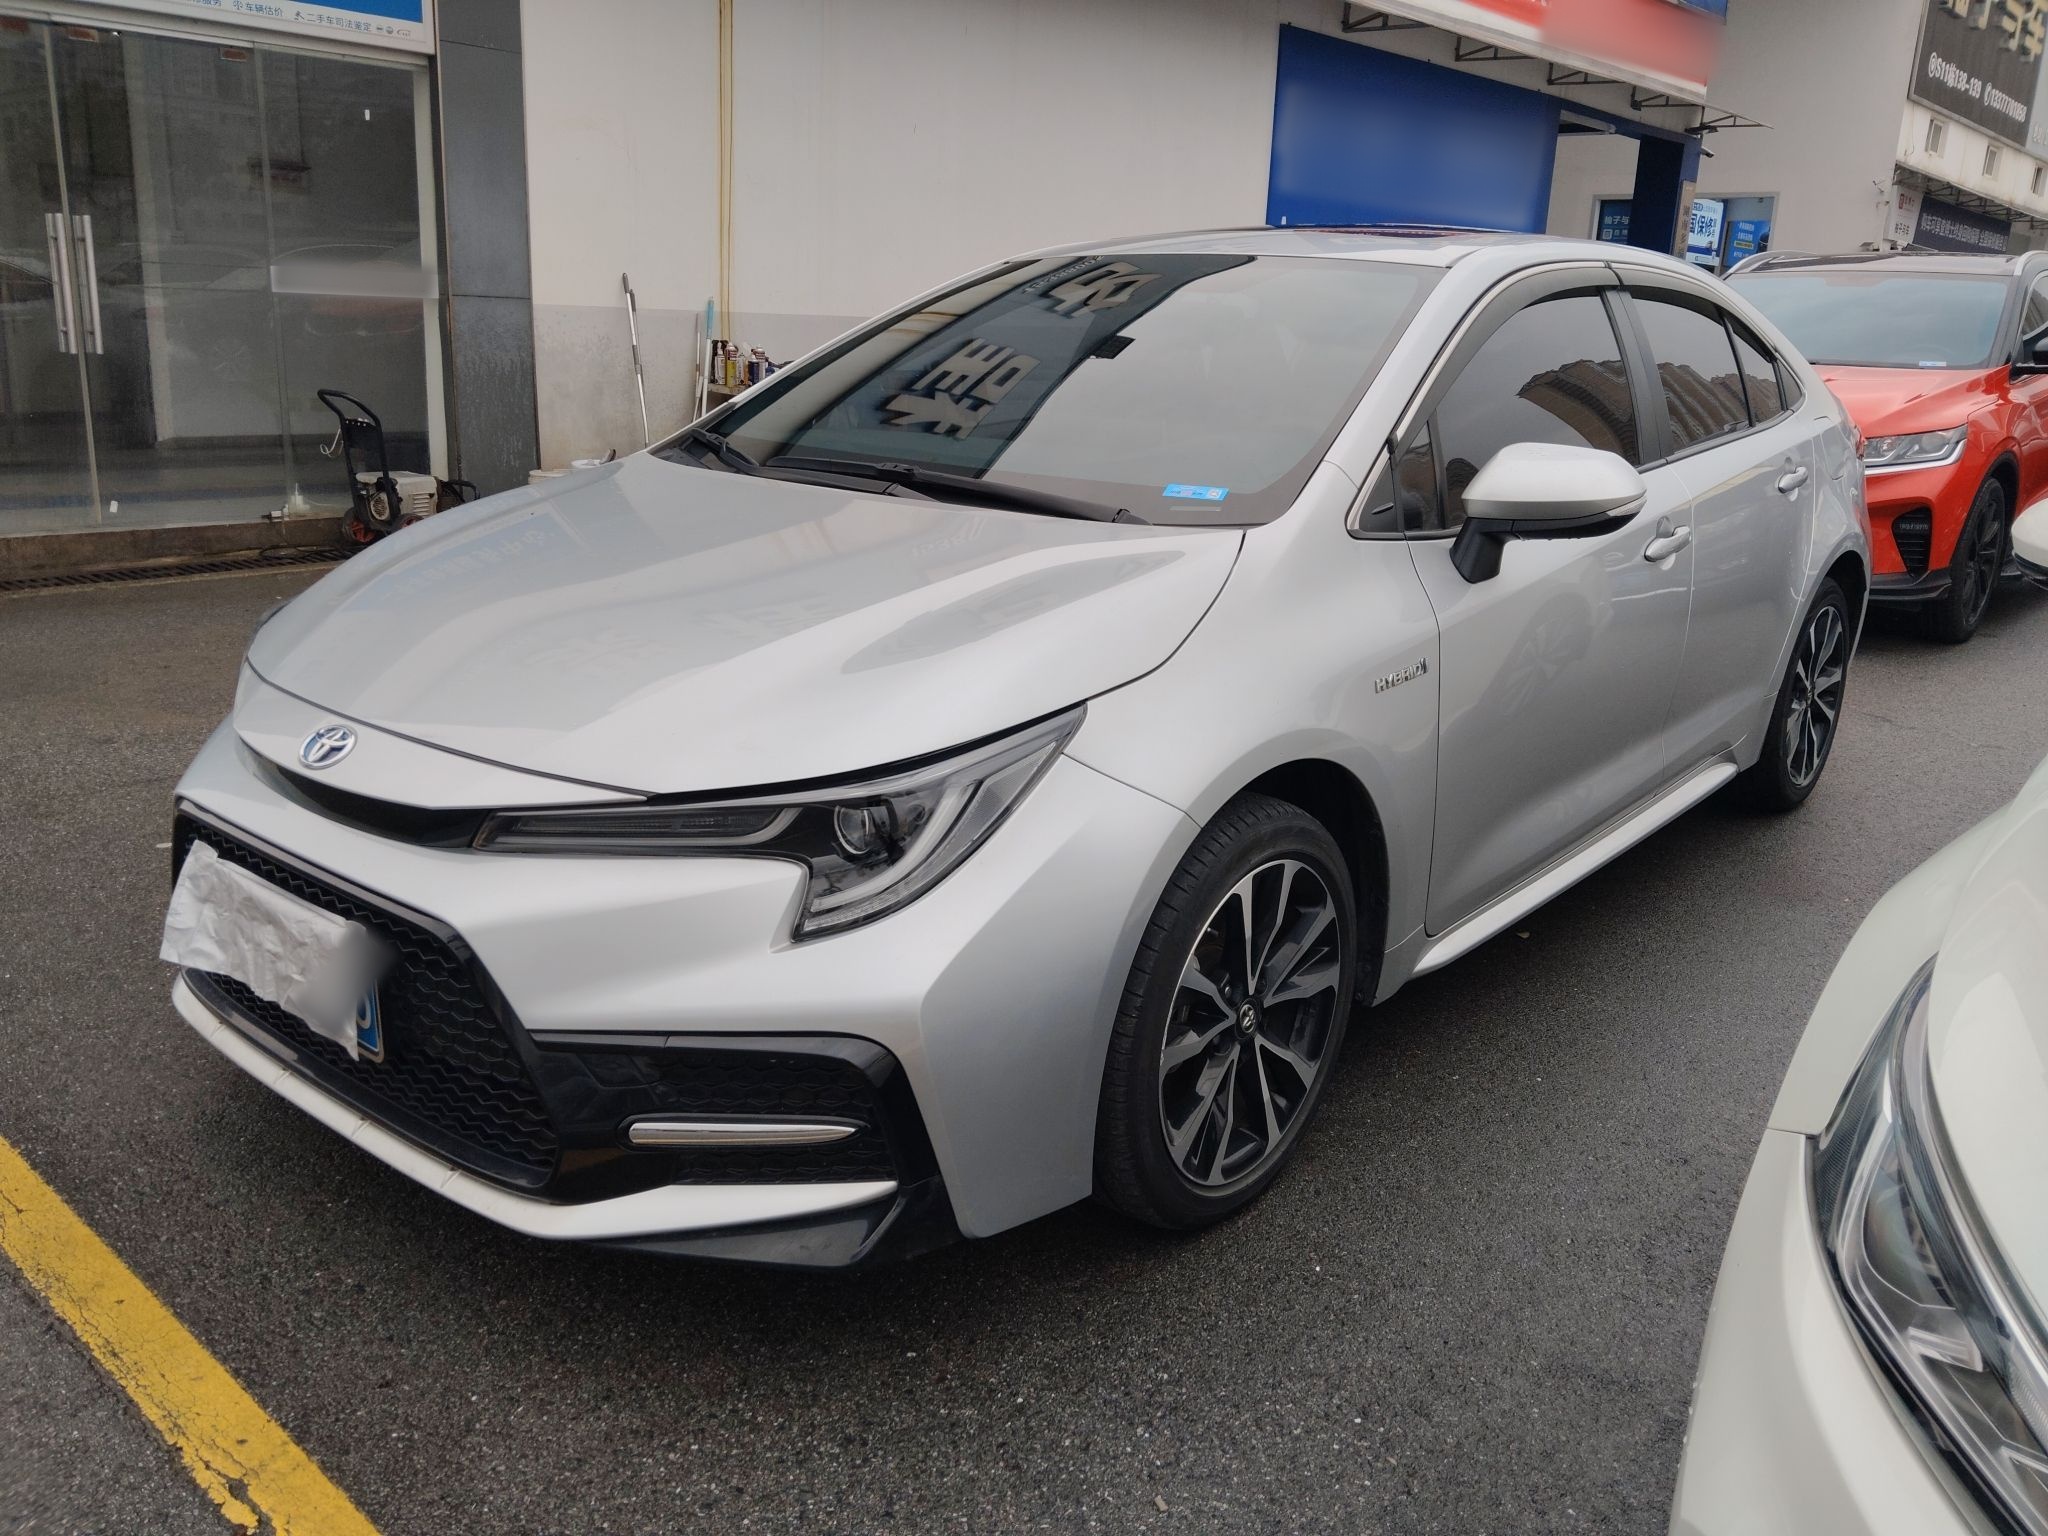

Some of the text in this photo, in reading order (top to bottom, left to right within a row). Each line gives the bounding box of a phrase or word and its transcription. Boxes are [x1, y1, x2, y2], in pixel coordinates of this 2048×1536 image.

[246, 2, 283, 17] 车辆估价
[307, 13, 372, 31] 二手车司法鉴定
[1375, 660, 1425, 694] HYBRID
